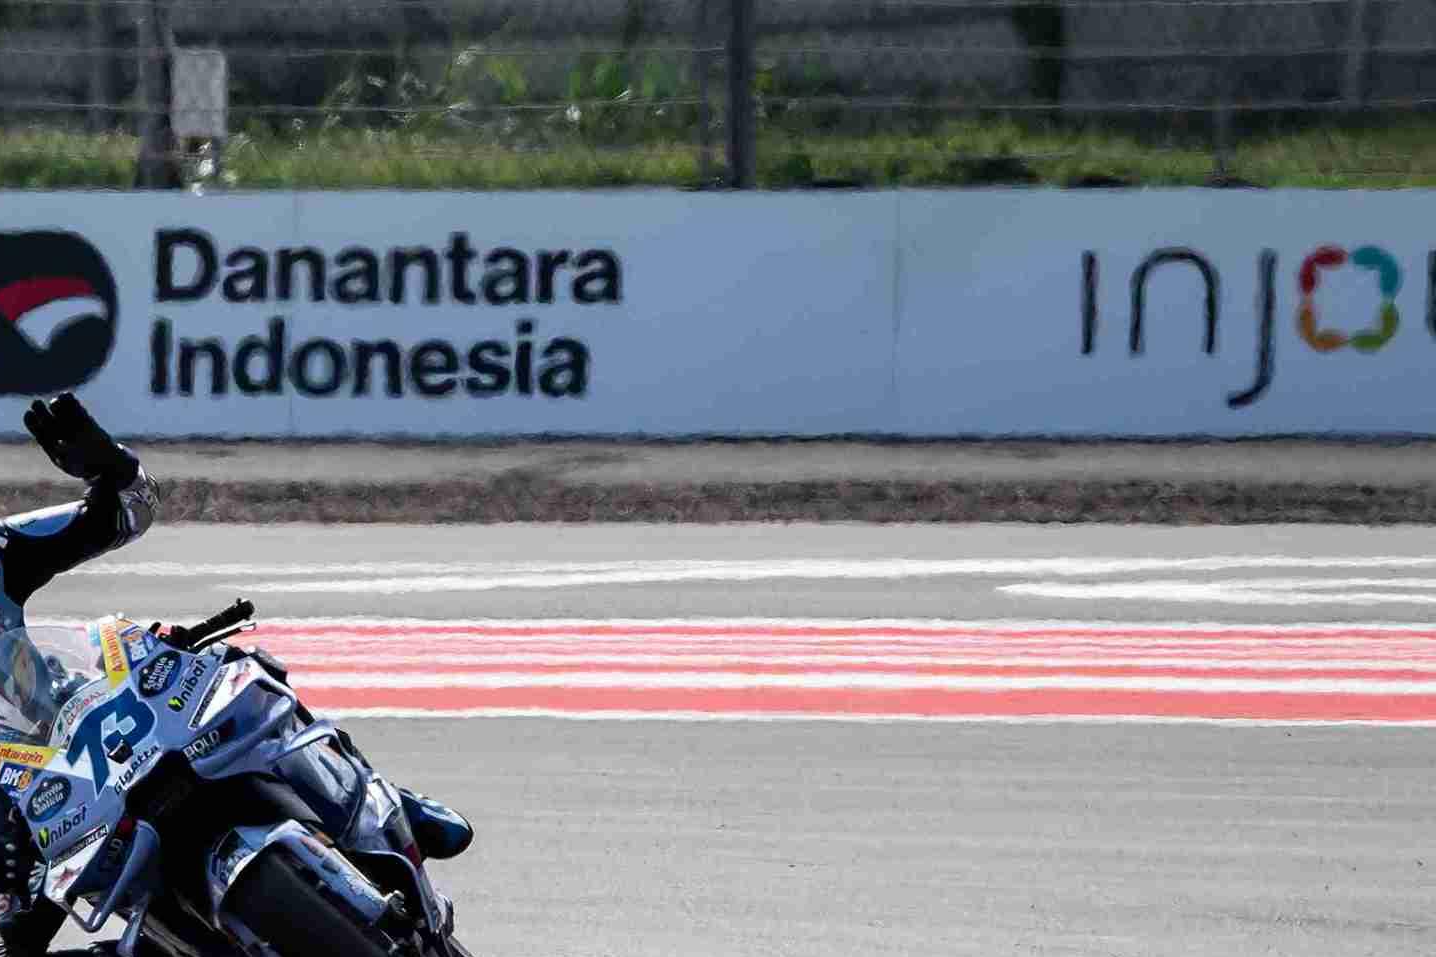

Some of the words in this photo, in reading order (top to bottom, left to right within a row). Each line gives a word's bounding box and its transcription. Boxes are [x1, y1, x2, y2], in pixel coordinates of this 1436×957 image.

[156, 229, 621, 304] Danantara
[151, 318, 589, 398] Indonesia
[66, 687, 156, 796] 73
